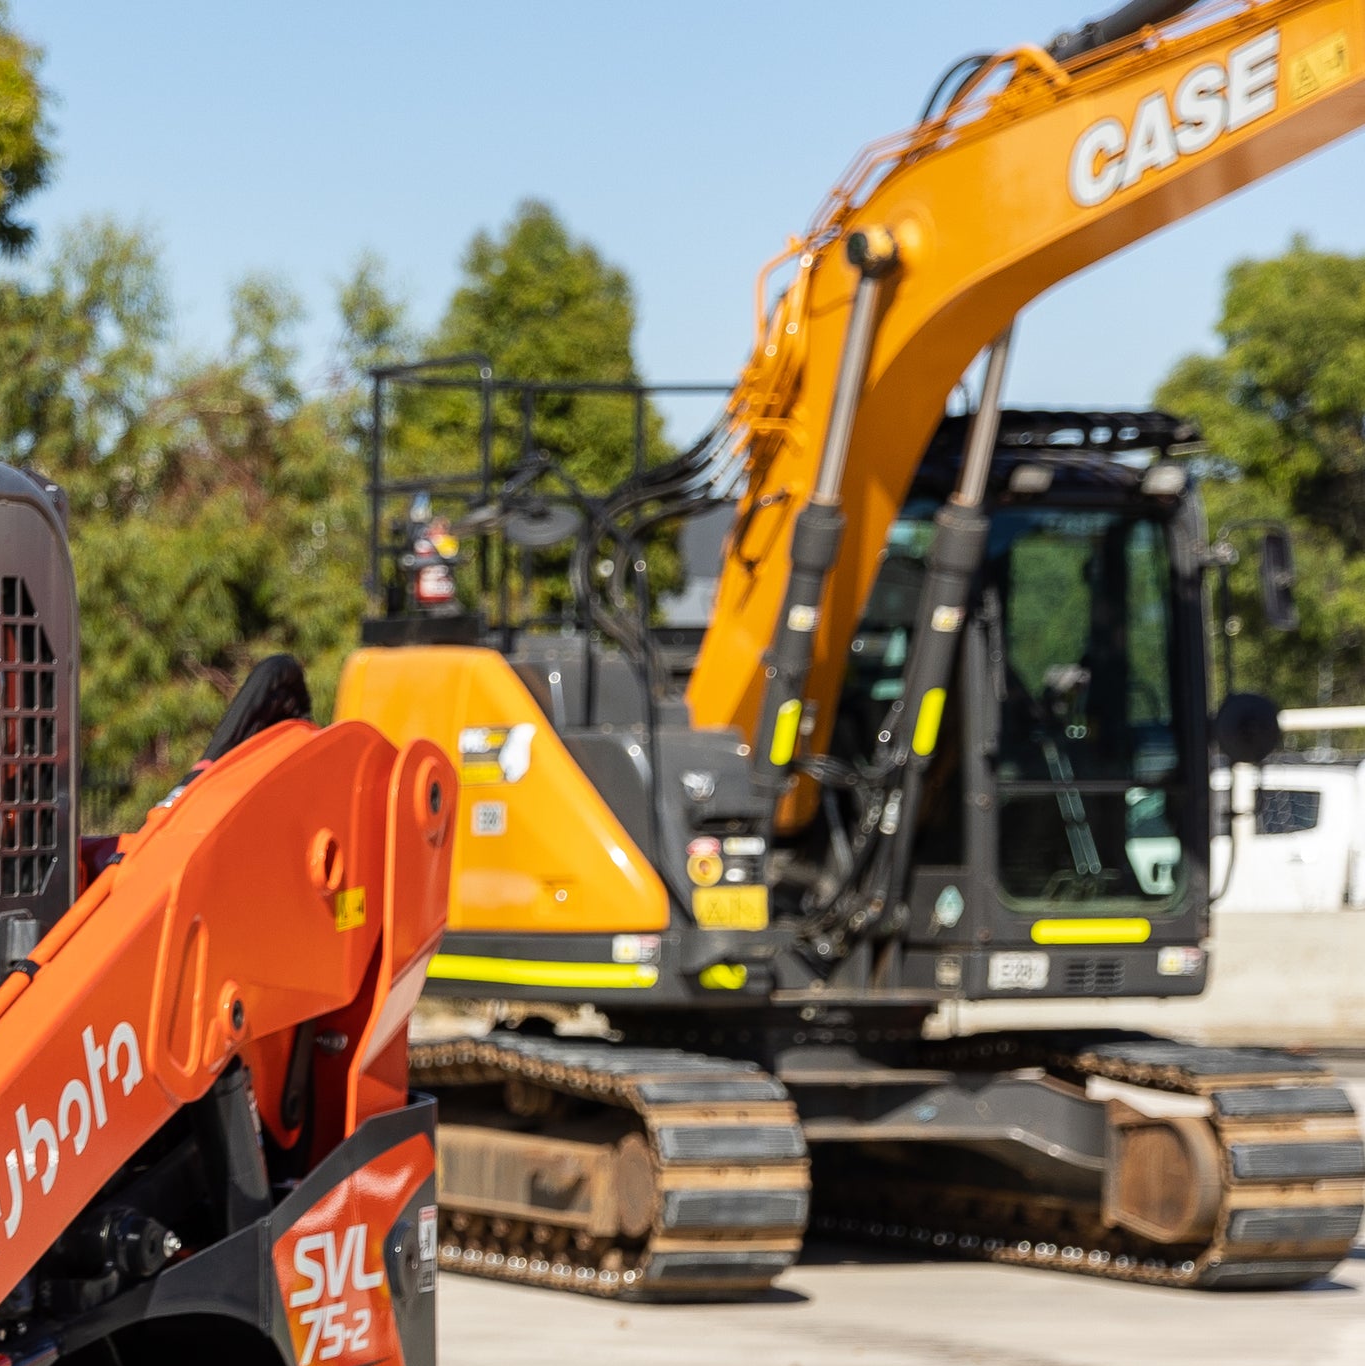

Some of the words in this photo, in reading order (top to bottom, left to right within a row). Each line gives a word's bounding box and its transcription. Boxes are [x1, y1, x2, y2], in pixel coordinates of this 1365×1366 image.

[1070, 26, 1282, 207] CASE
[289, 1223, 385, 1305] SVL
[299, 1301, 372, 1366] 75-2
